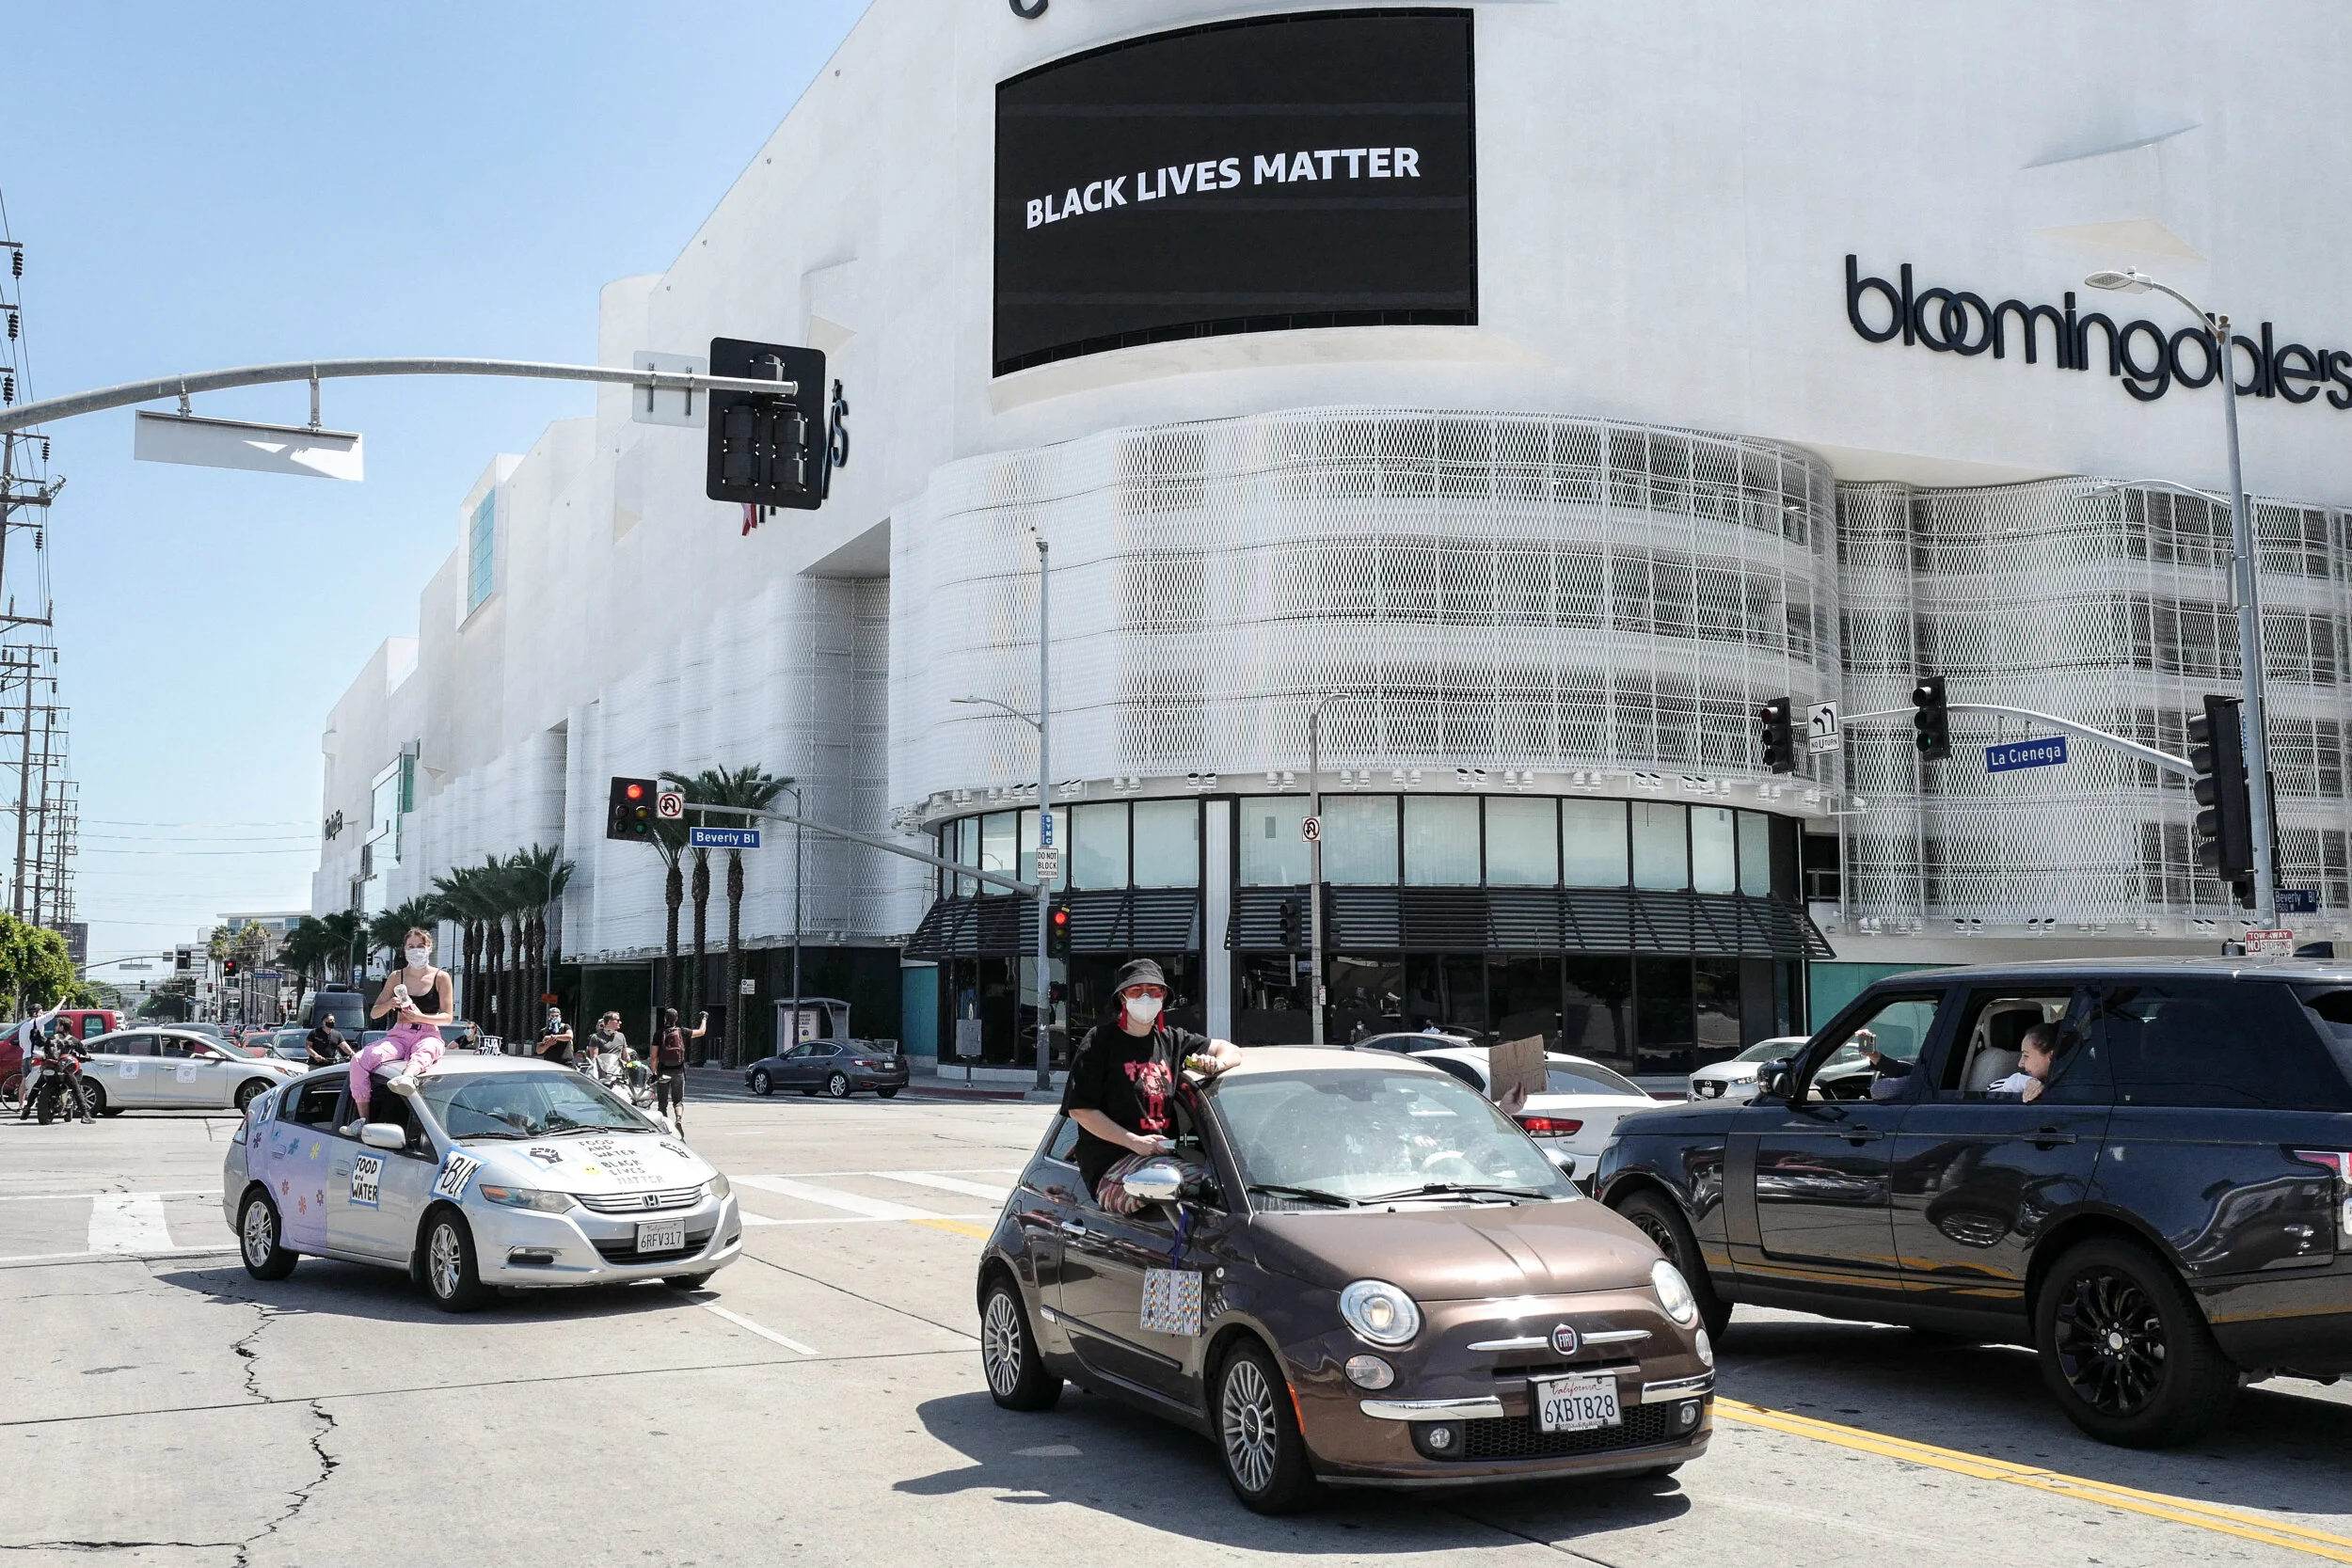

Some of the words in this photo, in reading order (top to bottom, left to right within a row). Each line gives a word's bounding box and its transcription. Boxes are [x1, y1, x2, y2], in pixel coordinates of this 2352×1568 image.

[1026, 172, 1128, 230] BLACK
[1136, 157, 1241, 202] LIVES
[1254, 147, 1421, 185] MATTER
[1819, 739, 1824, 749] U
[1991, 752, 2005, 766] La
[2010, 746, 2061, 763] Cienega
[696, 832, 739, 846] Beverly
[743, 833, 755, 844] Bl
[1038, 851, 1045, 860] DO
[1038, 862, 1057, 870] BLOCK
[2275, 891, 2301, 906] Beverly
[2248, 941, 2261, 951] NO
[2262, 941, 2291, 950] STOPPING
[593, 1149, 639, 1158] WATER
[355, 1157, 377, 1174] FOOD
[600, 1159, 643, 1168] BLACK
[609, 1167, 645, 1176] LIVES
[617, 1175, 666, 1185] MATTER
[351, 1182, 378, 1201] WATER
[641, 1231, 681, 1248] 6RFV317
[1557, 1334, 1573, 1348] FIAT
[1552, 1382, 1602, 1397] California
[1545, 1395, 1615, 1423] 6XBT828
